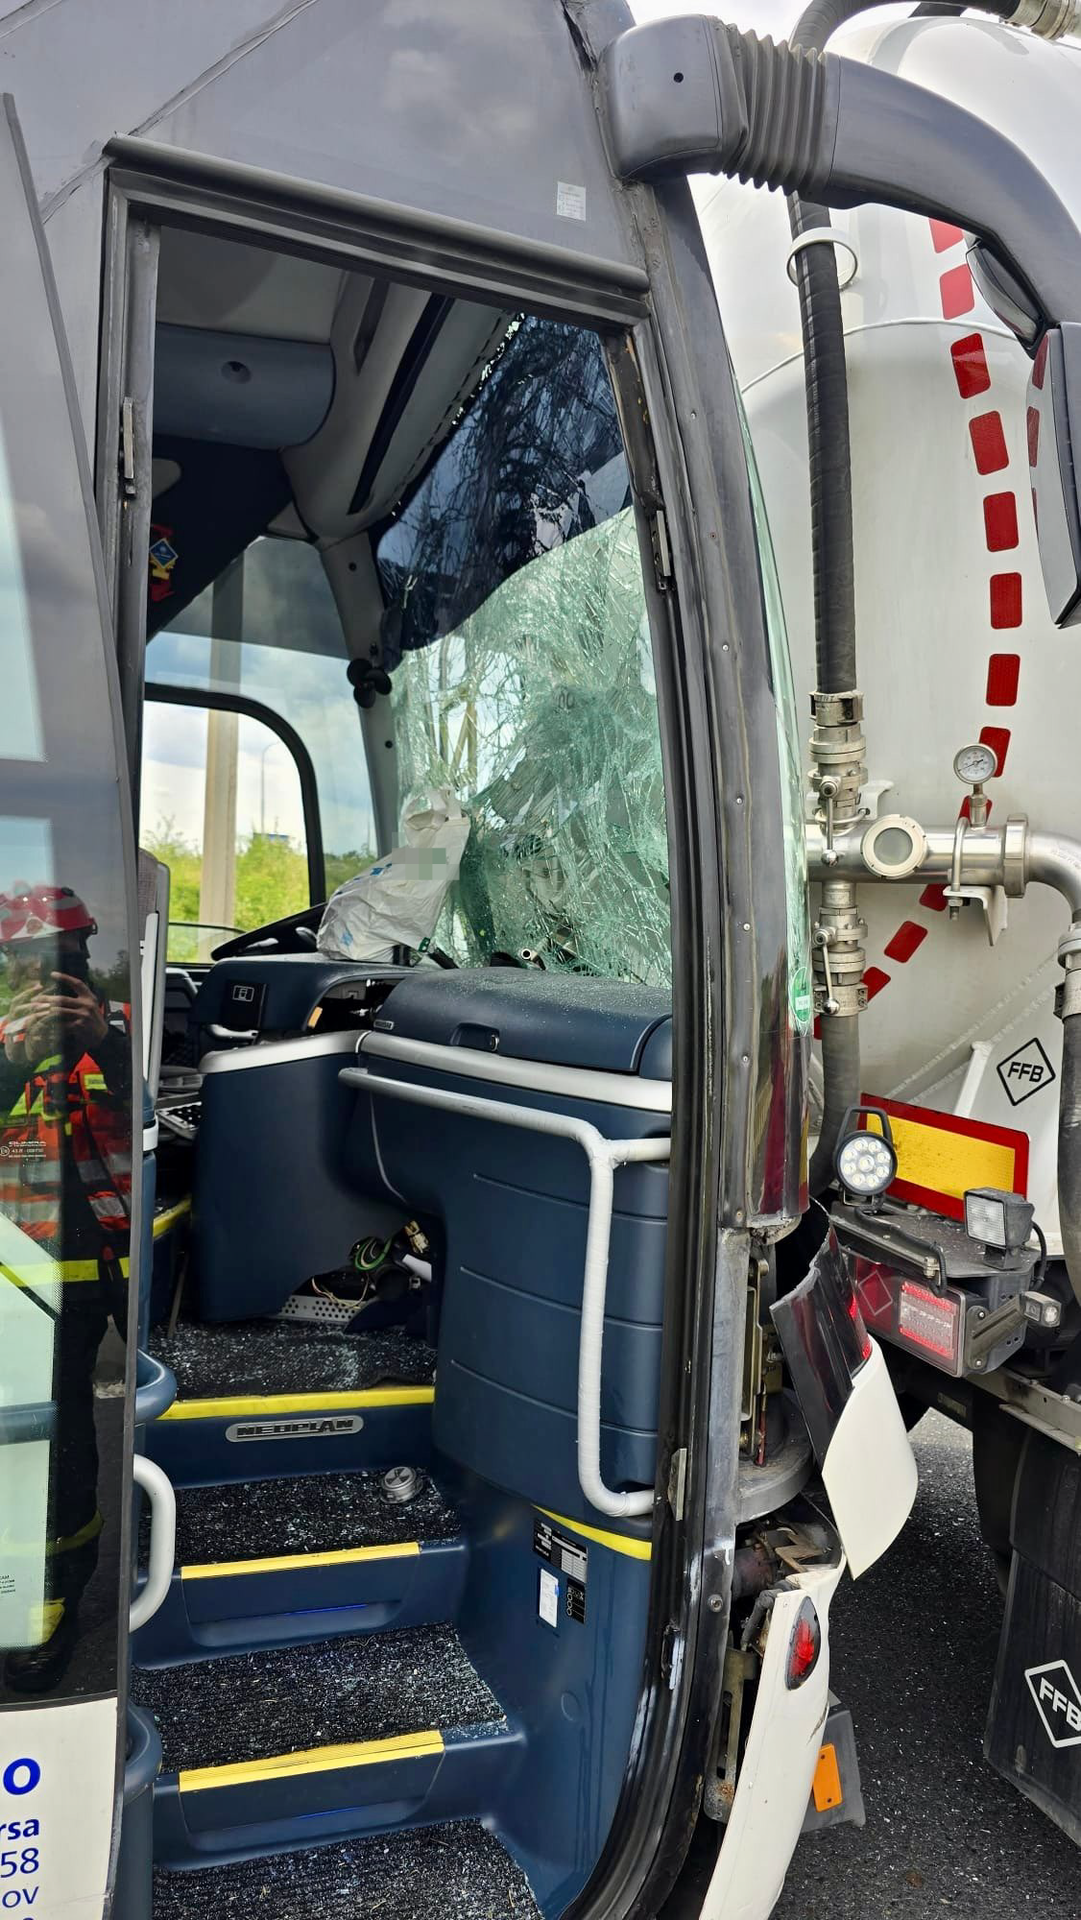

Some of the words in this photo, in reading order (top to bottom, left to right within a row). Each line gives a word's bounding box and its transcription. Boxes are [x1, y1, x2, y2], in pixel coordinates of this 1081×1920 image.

[1007, 1061, 1044, 1082] FFB
[237, 1419, 354, 1437] NEOPLAN
[1039, 1676, 1081, 1731] FFB
[0, 1847, 39, 1878] 58
